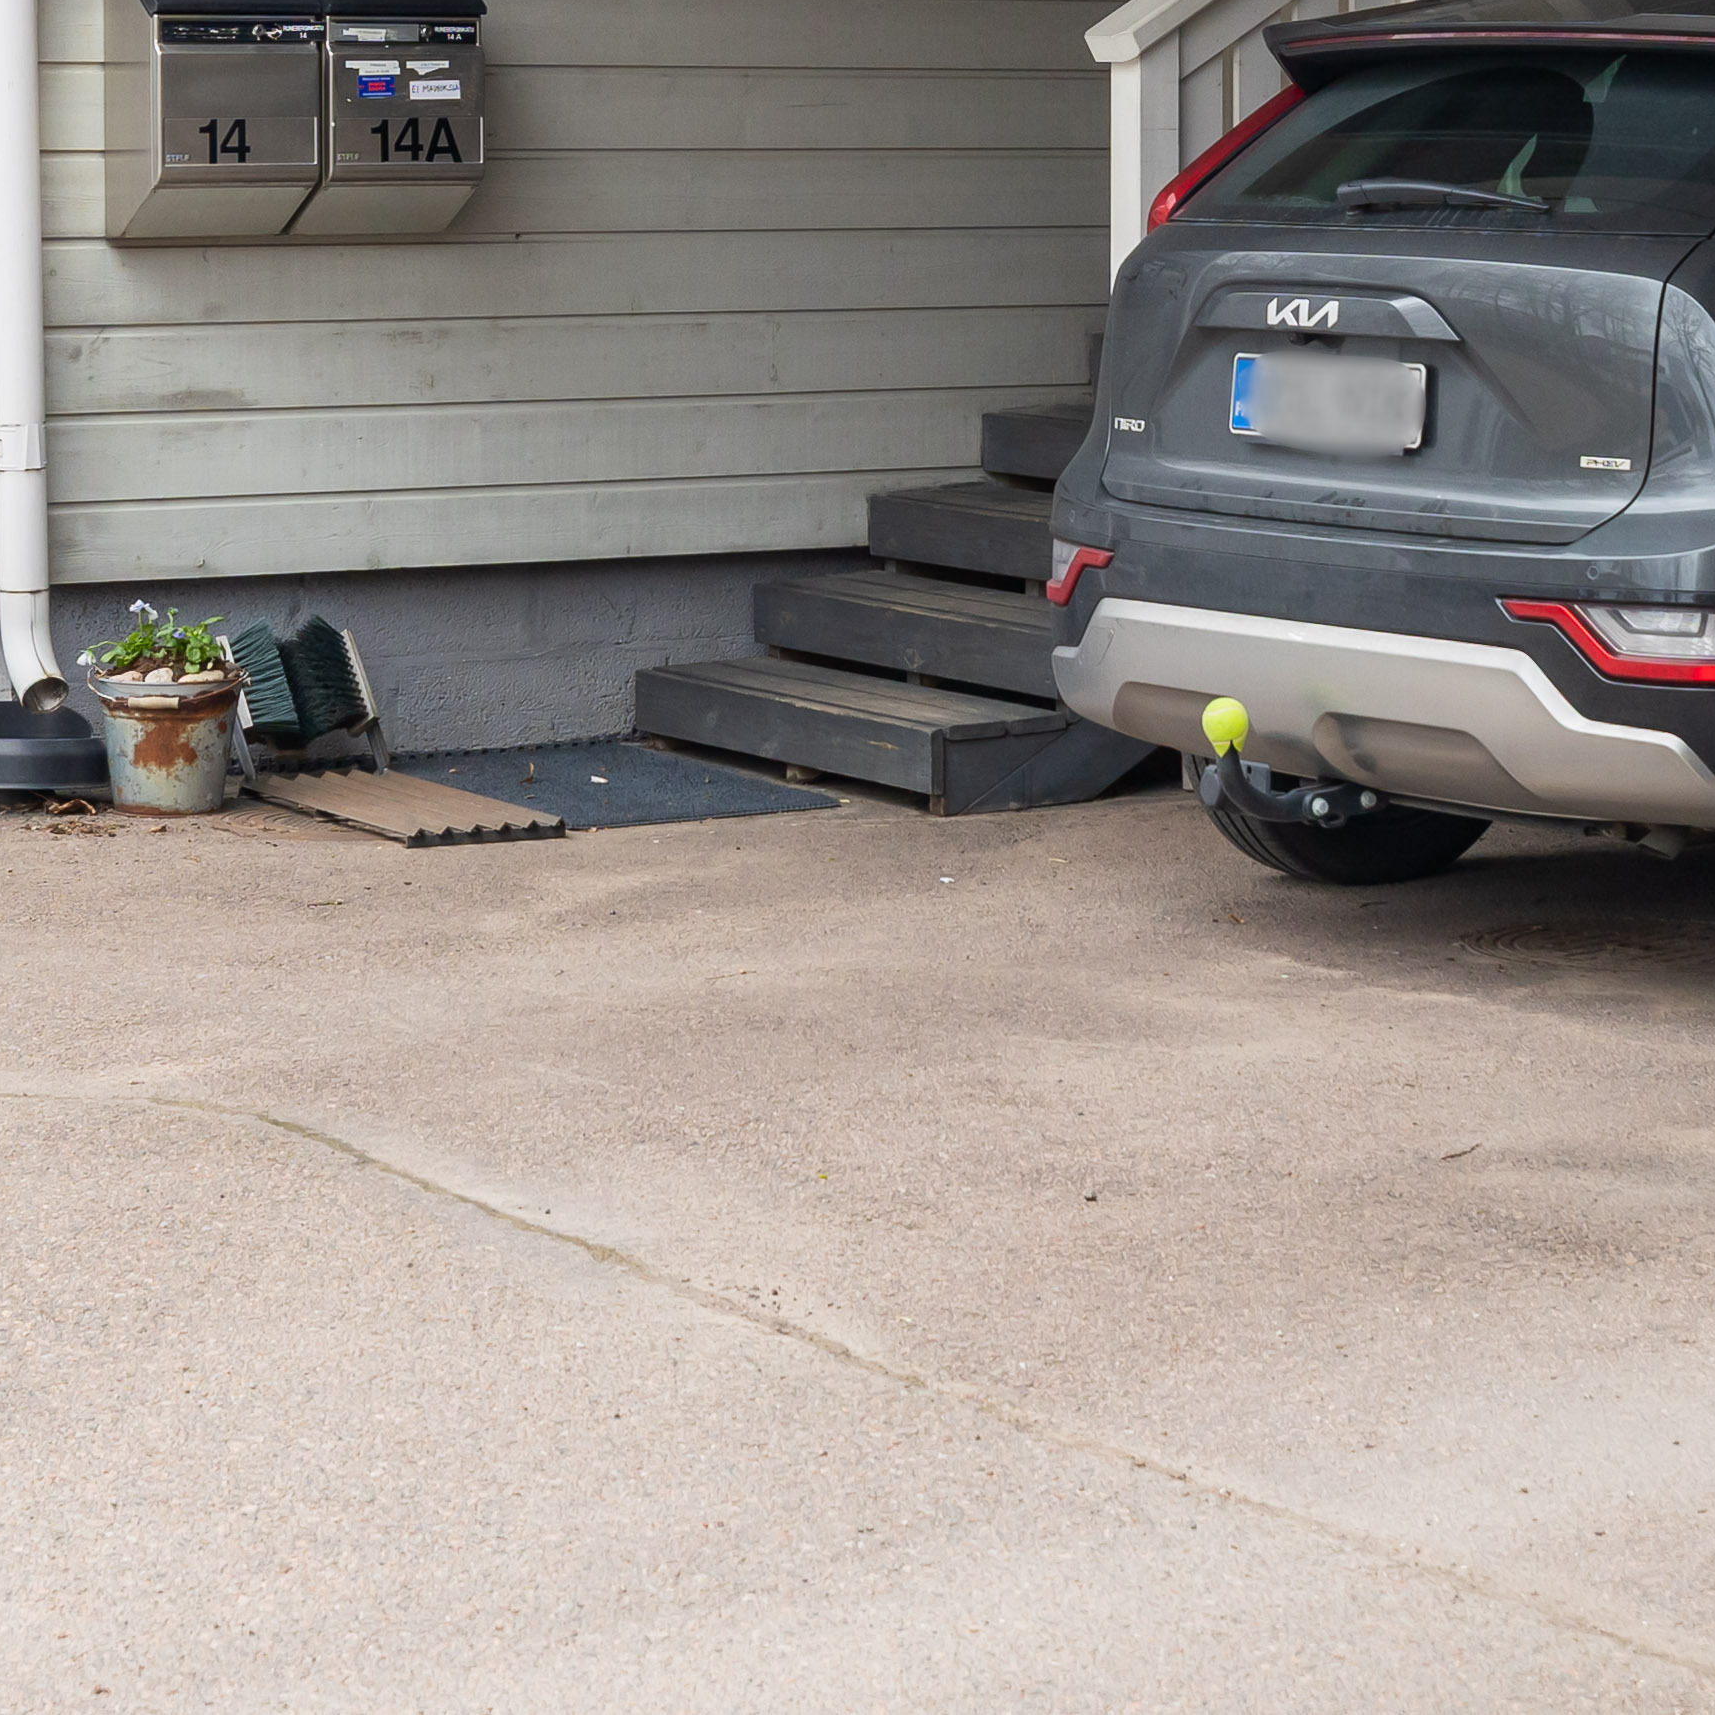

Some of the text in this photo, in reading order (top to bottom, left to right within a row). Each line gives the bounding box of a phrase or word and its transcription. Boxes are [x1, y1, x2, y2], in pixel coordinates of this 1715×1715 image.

[198, 118, 251, 164] 14
[370, 117, 463, 163] 14A
[1266, 297, 1339, 327] KIA
[1114, 416, 1146, 432] NIRO
